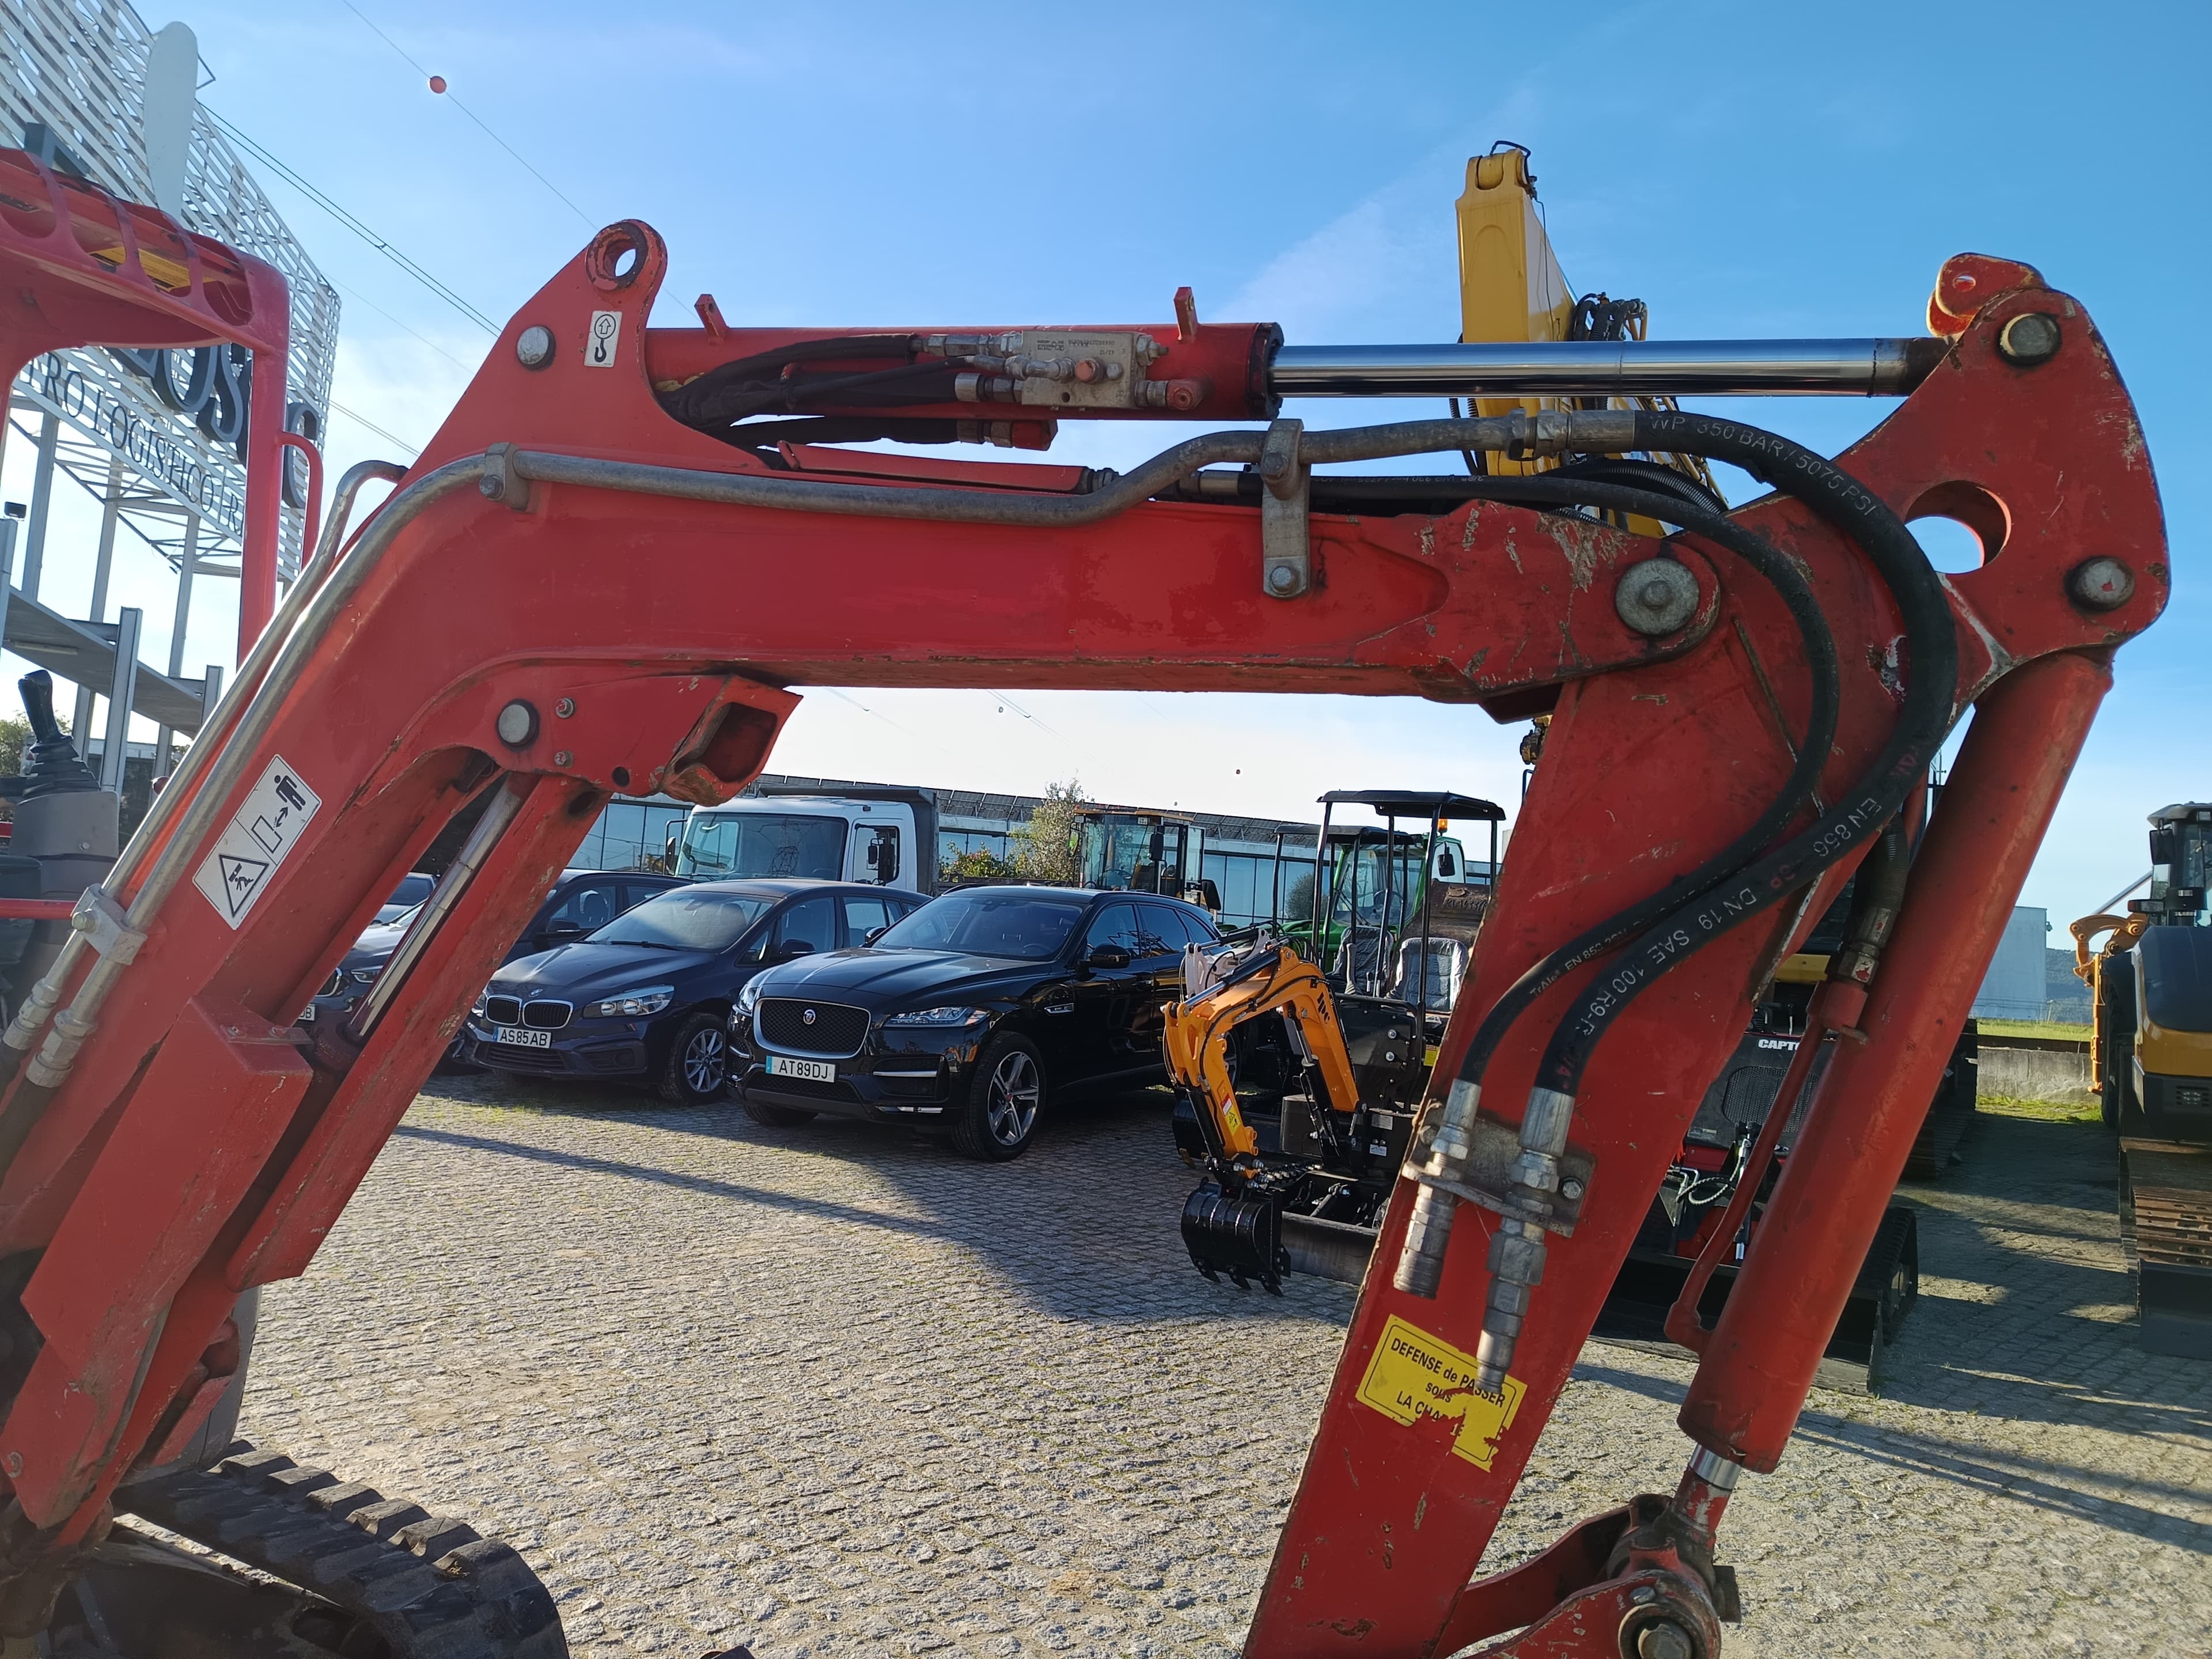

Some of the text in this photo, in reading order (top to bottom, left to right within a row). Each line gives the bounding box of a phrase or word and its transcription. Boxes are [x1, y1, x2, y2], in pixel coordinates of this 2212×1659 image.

[1650, 416, 1685, 430] WP
[1697, 421, 1735, 440] 350
[1738, 429, 1784, 456] BAR
[1796, 454, 1844, 488] 5075
[1842, 484, 1877, 516] PSI
[1848, 797, 1882, 828] EN
[1813, 824, 1851, 857] 856
[1723, 888, 1758, 916] DN
[1698, 909, 1722, 930] 19
[1646, 929, 1690, 965] SAE
[1565, 955, 1582, 971] EN
[1612, 963, 1645, 993] 100
[1391, 1338, 1443, 1374] DEFENSE
[1443, 1367, 1458, 1382] de
[1396, 1391, 1412, 1410] LA
